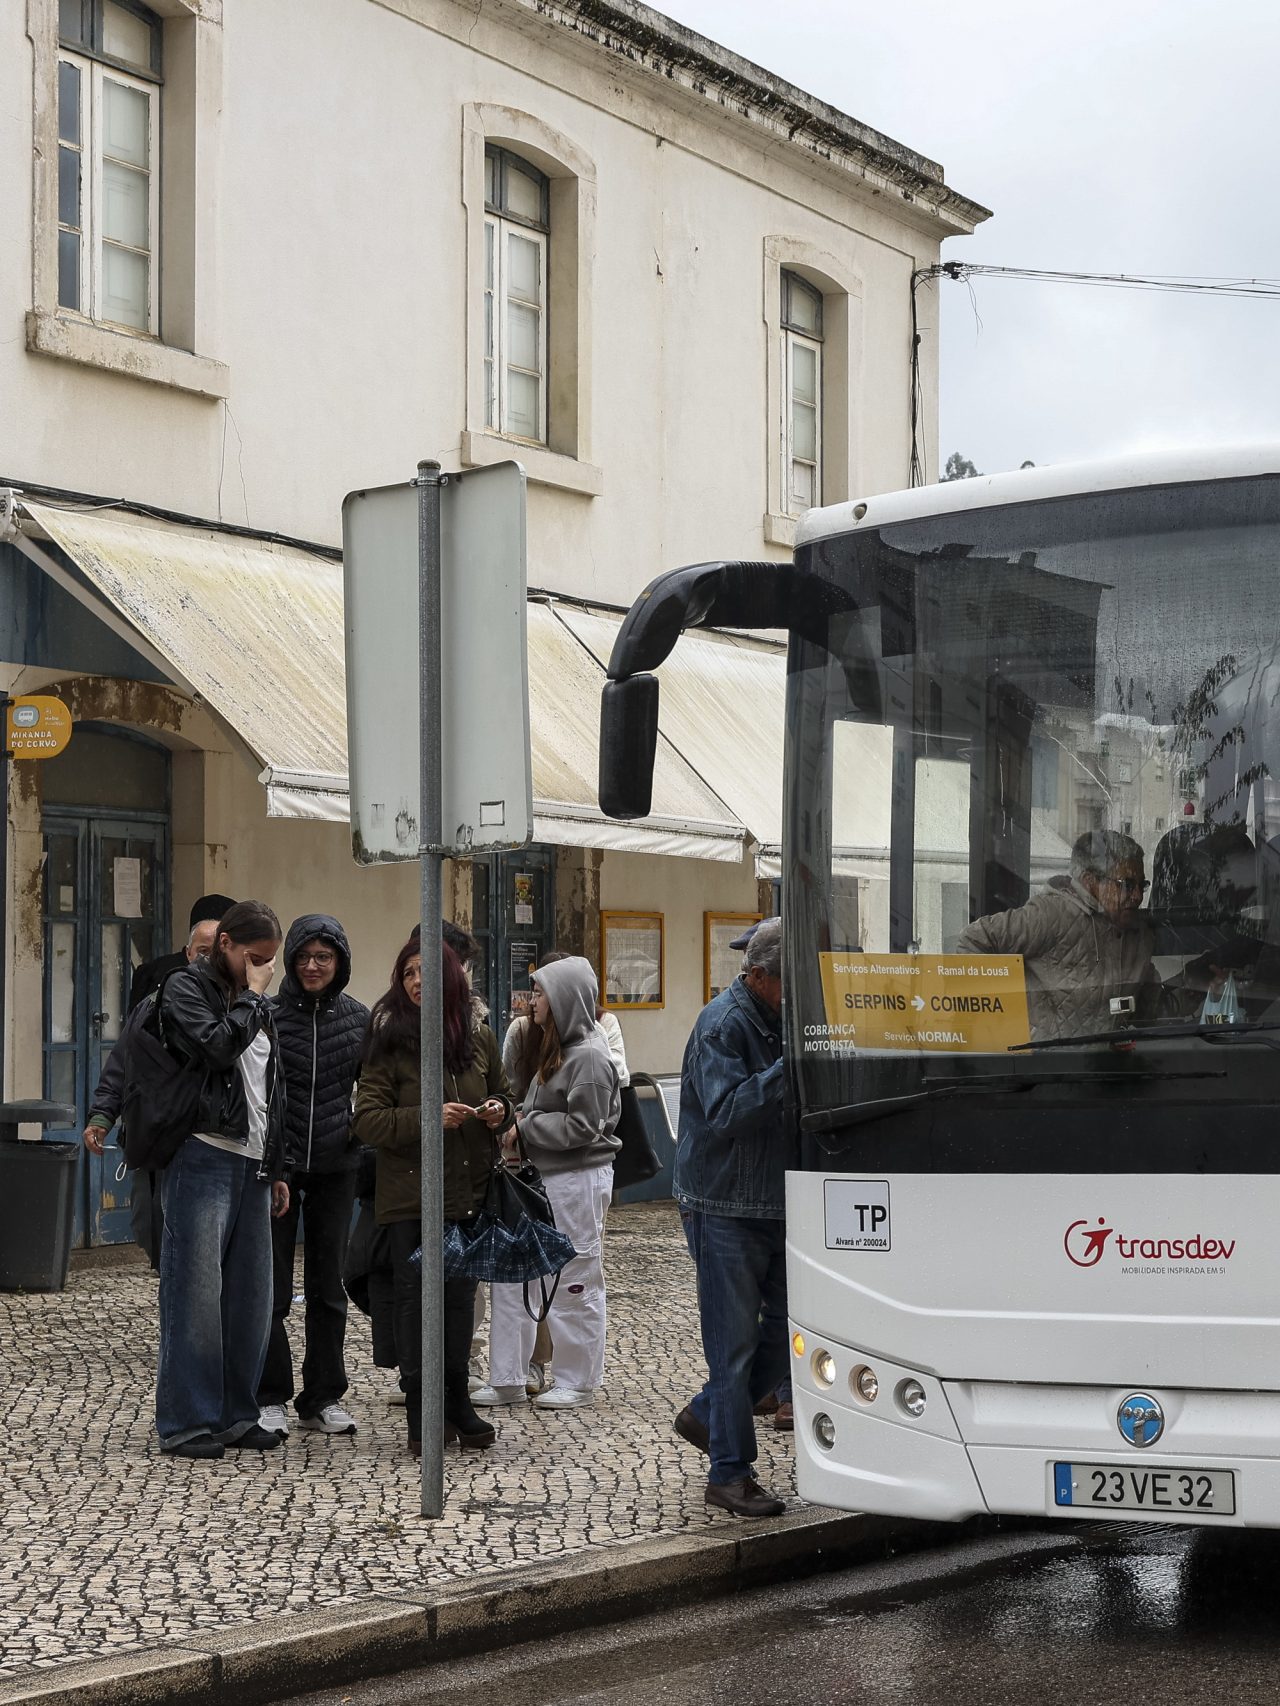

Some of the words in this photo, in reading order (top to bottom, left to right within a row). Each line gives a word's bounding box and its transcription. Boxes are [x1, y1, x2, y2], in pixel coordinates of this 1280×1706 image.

[11, 731, 52, 739] MIRANDA
[27, 740, 57, 748] CORVO
[833, 963, 868, 976] Serviços
[870, 964, 920, 975] Alternativos
[937, 965, 966, 976] Ramal
[967, 966, 979, 976] da
[981, 965, 1009, 976] Lousã
[845, 993, 906, 1011] SERPINS
[930, 995, 1004, 1013] COIMBRA
[803, 1024, 856, 1036] COBRANÇA
[884, 1031, 915, 1042] Serviço
[917, 1031, 967, 1043] NORMAL
[804, 1040, 856, 1052] MOTORISTA
[854, 1204, 887, 1232] TP
[835, 1237, 854, 1246] Alvará
[863, 1238, 887, 1247] 200024
[1115, 1233, 1236, 1260] transdev
[1121, 1267, 1166, 1275] MOBILIDADE
[1167, 1267, 1206, 1275] INSPIRADA
[1206, 1267, 1219, 1275] EM
[1219, 1267, 1226, 1275] SI
[1061, 1488, 1068, 1498] P
[1091, 1470, 1125, 1503] 23
[1130, 1472, 1172, 1506] VE
[1177, 1475, 1213, 1508] 32
